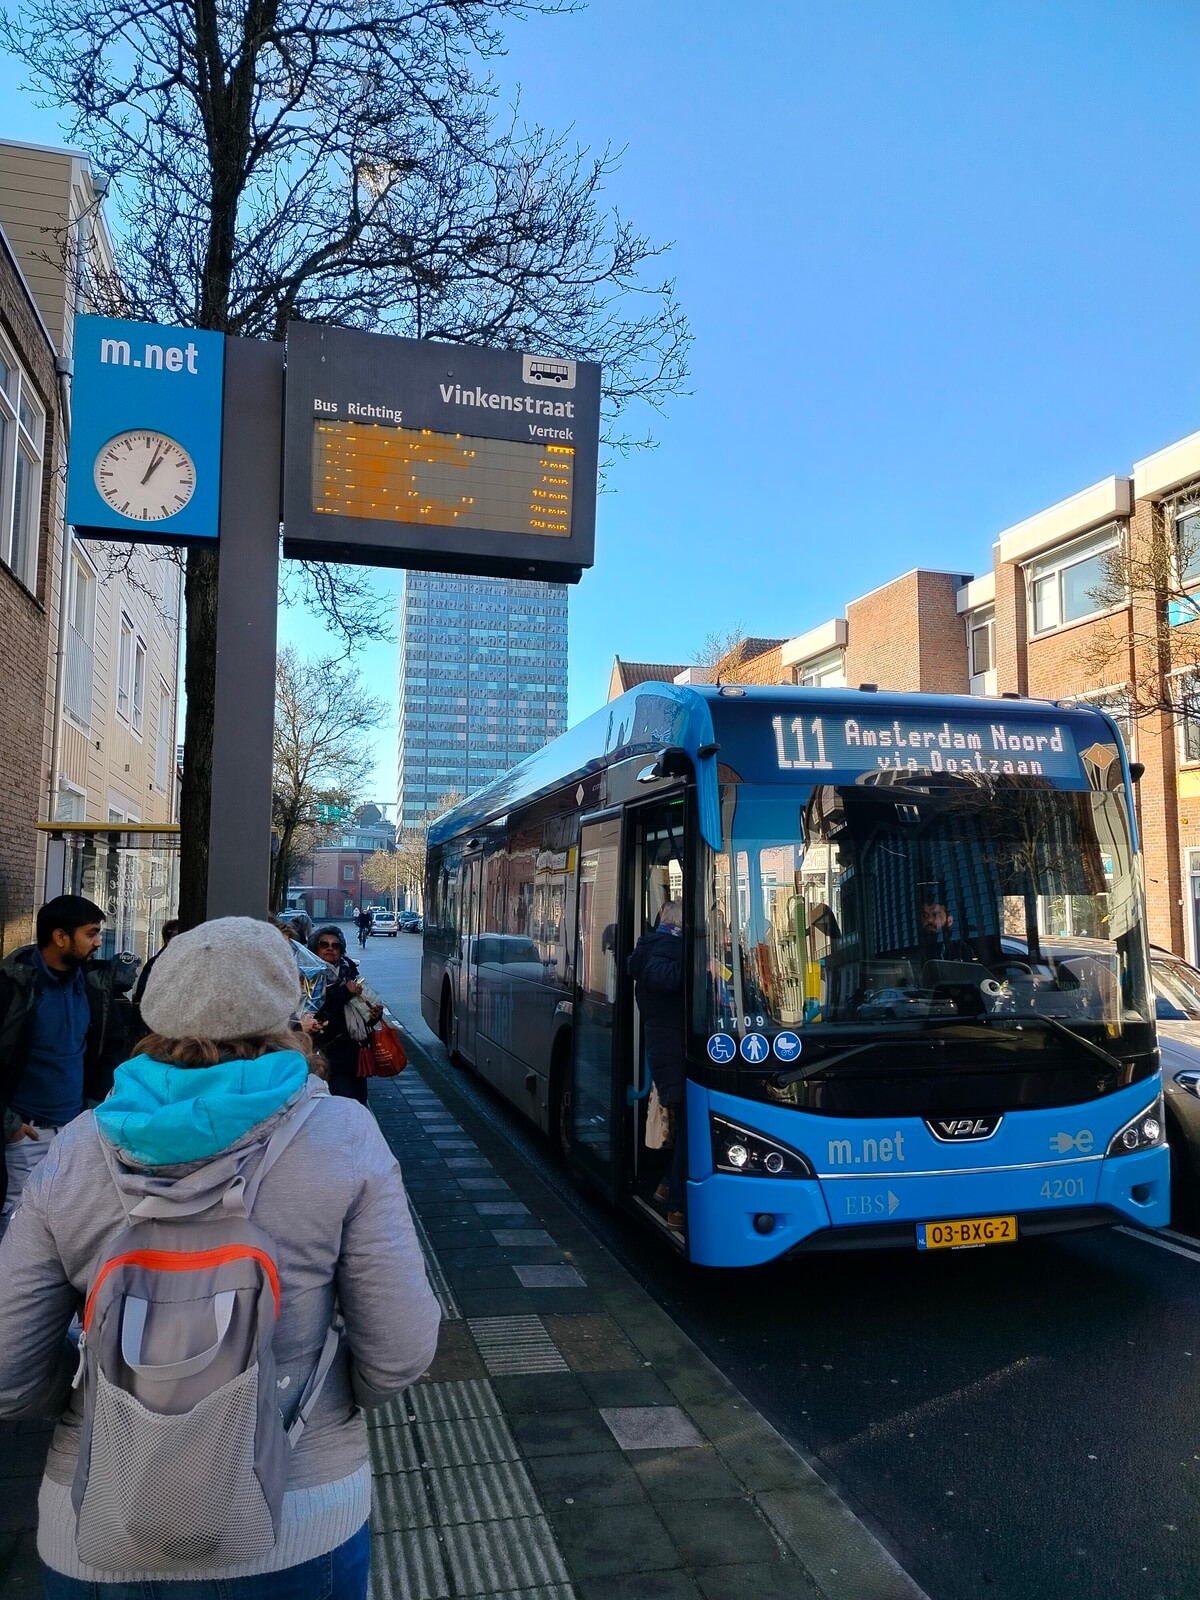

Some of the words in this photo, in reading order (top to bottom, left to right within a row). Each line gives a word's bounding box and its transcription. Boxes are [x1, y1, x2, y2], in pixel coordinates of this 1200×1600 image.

[100, 338, 198, 375] m.net
[313, 399, 338, 413] Bus
[348, 403, 403, 423] Richting
[439, 383, 575, 419] Vinkenstraat
[528, 425, 574, 441] Vertrek
[772, 716, 833, 769] 111
[844, 720, 982, 750] Amsterdam
[991, 724, 1064, 753] Noord
[878, 752, 918, 771] via
[931, 750, 1043, 776] Oostzaan
[718, 1016, 765, 1029] 1709
[939, 1119, 989, 1135] VDL
[828, 1130, 905, 1165] m.net
[1040, 1178, 1084, 1199] 4201
[845, 1194, 885, 1216] EBS
[932, 1220, 1010, 1244] 03-BXG-2
